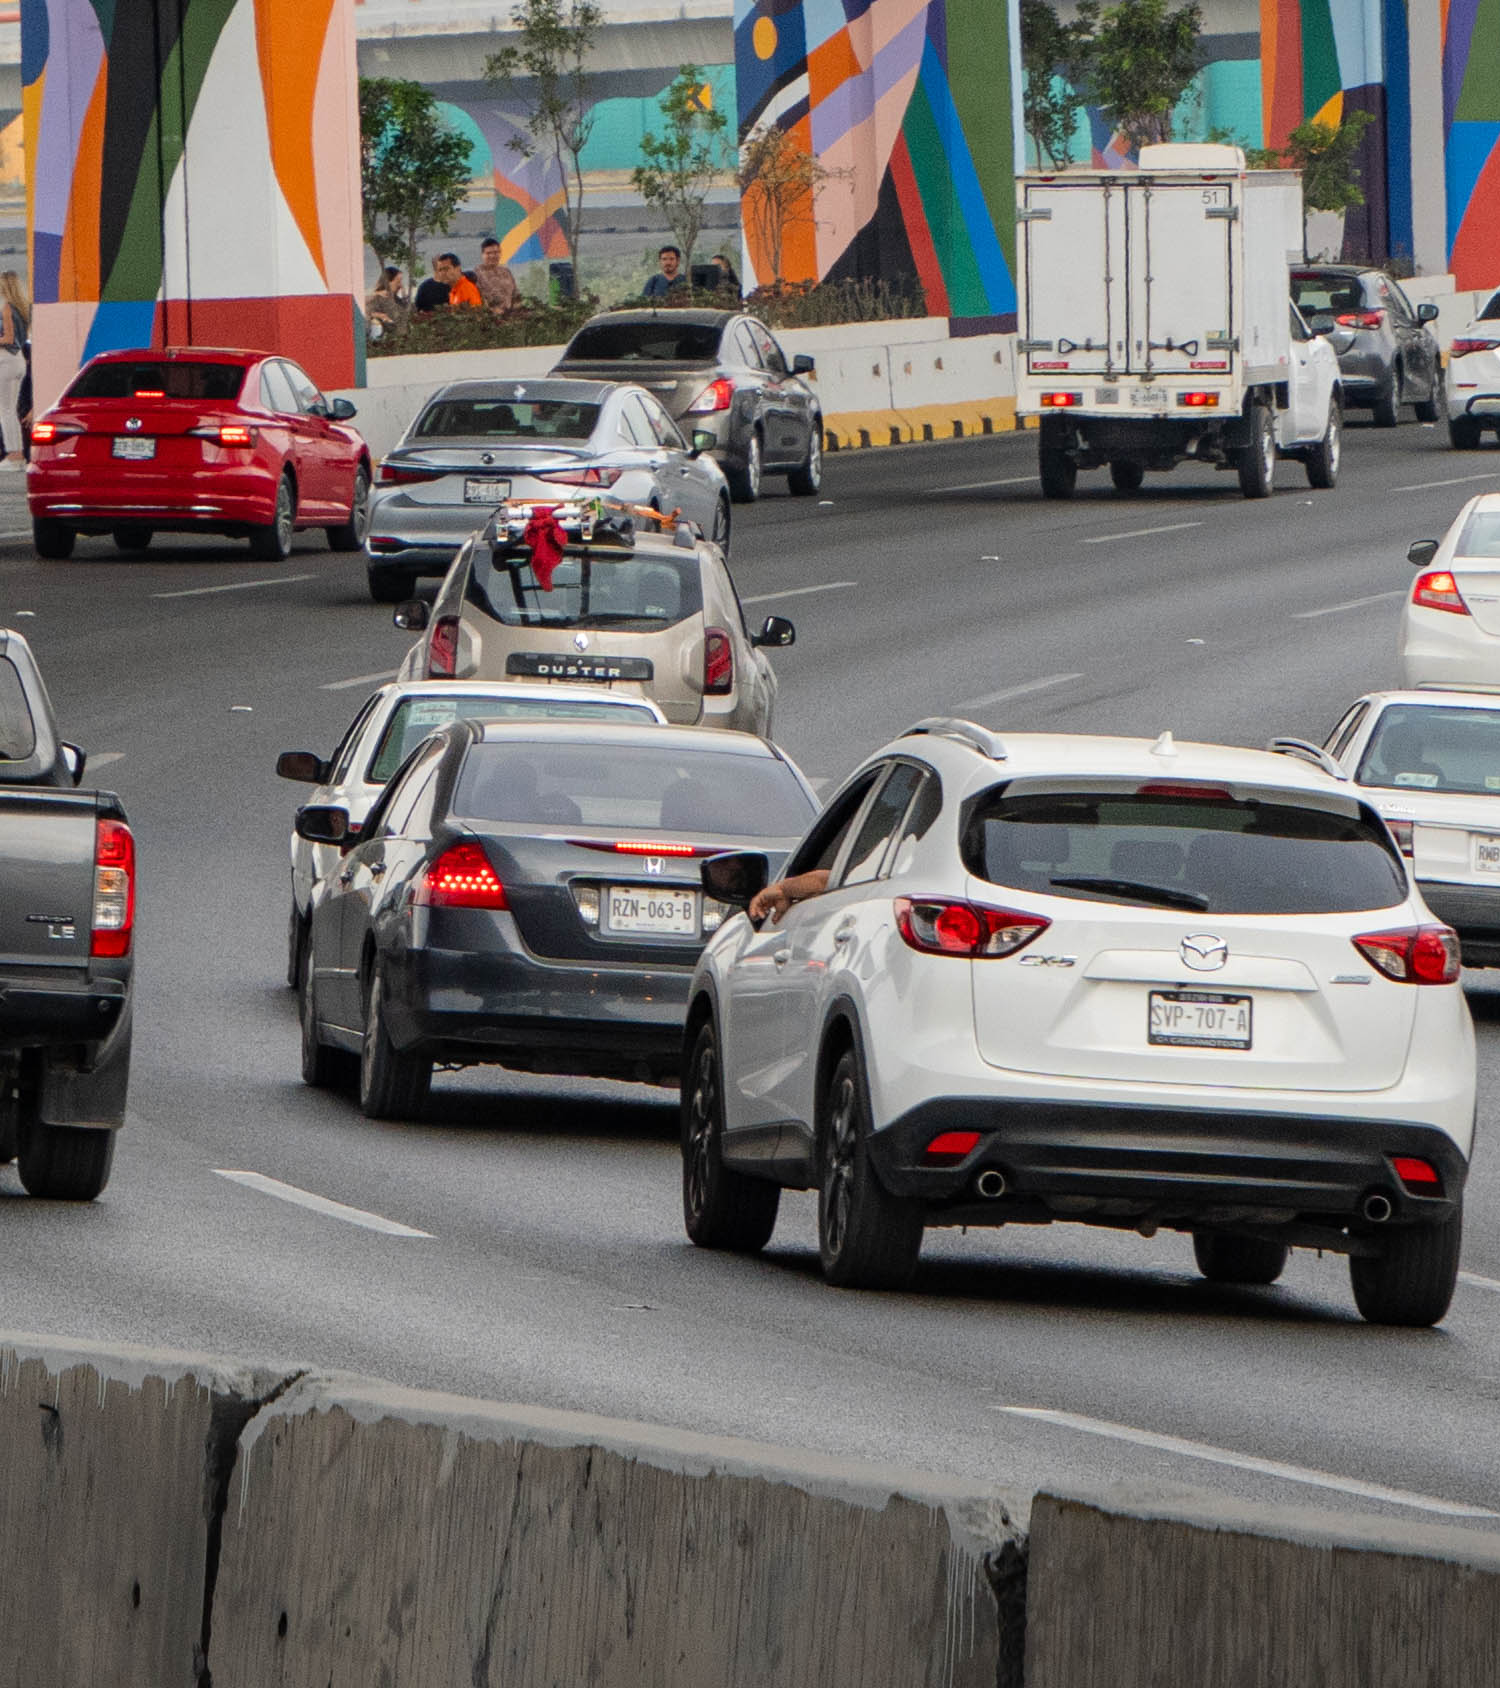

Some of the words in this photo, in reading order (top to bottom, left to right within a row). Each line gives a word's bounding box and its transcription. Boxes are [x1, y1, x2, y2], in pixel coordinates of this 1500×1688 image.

[1201, 191, 1217, 204] 51
[537, 664, 620, 678] DUSTER
[612, 898, 693, 920] RZN-063-B
[47, 924, 76, 940] LE
[1151, 1004, 1247, 1032] SVP-707-A
